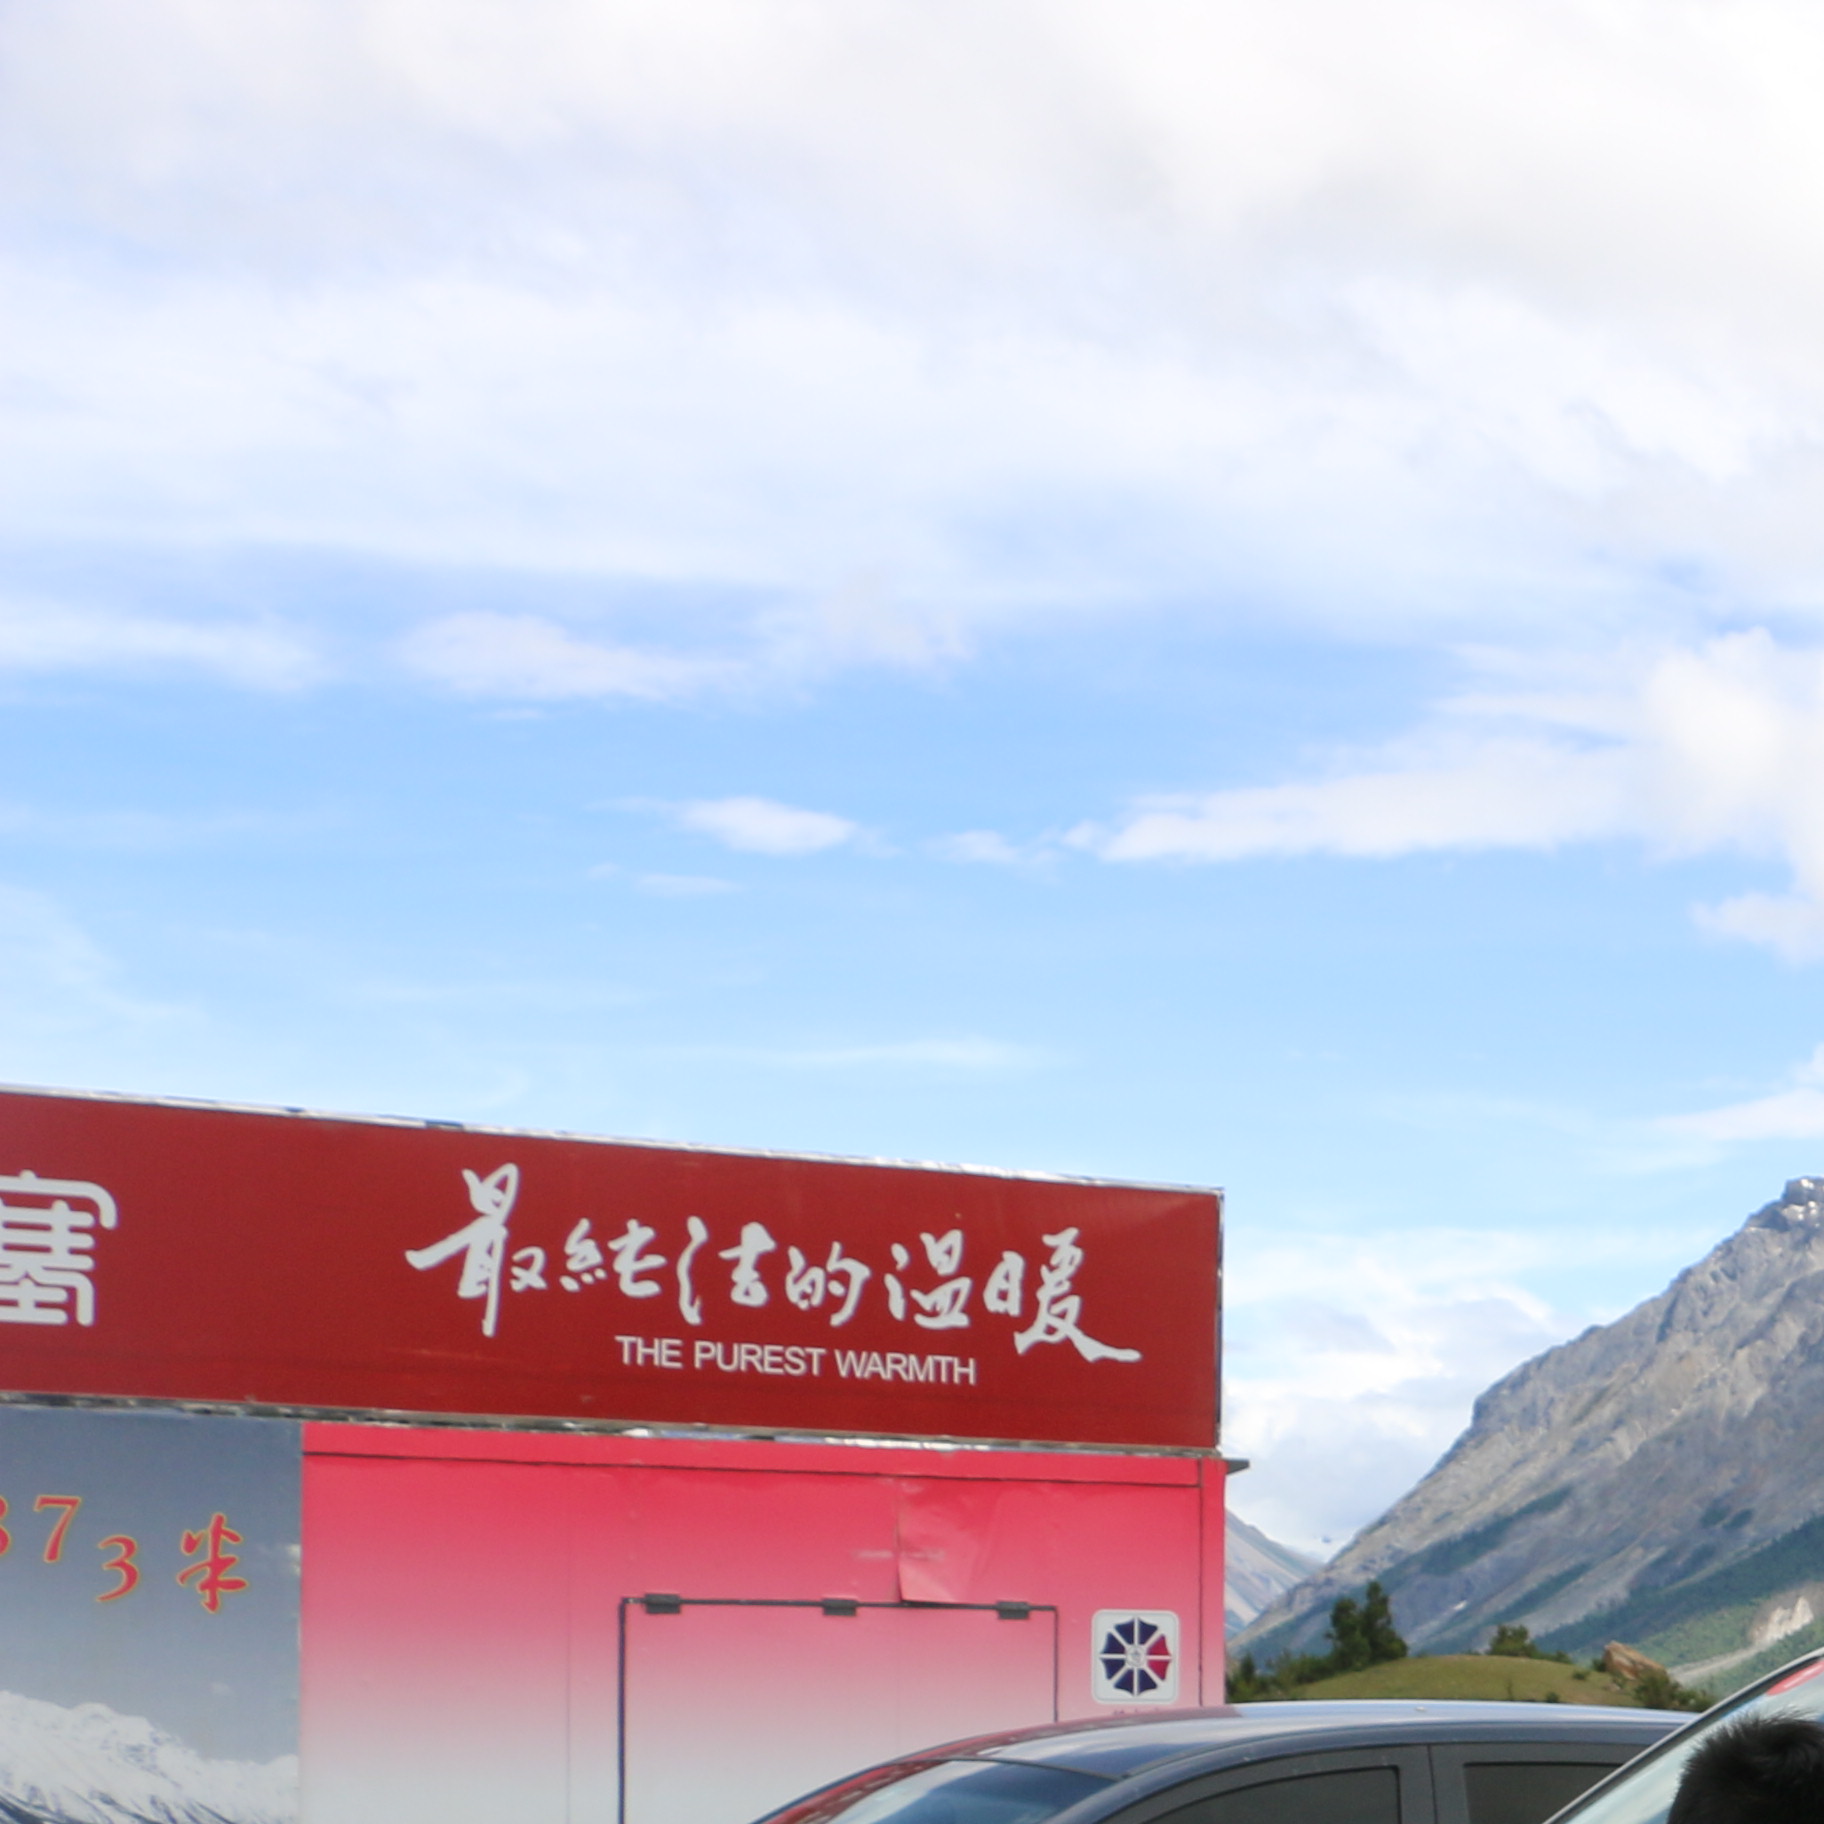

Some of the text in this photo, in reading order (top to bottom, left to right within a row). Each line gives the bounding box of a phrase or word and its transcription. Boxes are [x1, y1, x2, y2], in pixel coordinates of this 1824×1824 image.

[615, 1335, 977, 1386] THE PUREST WARMTH
